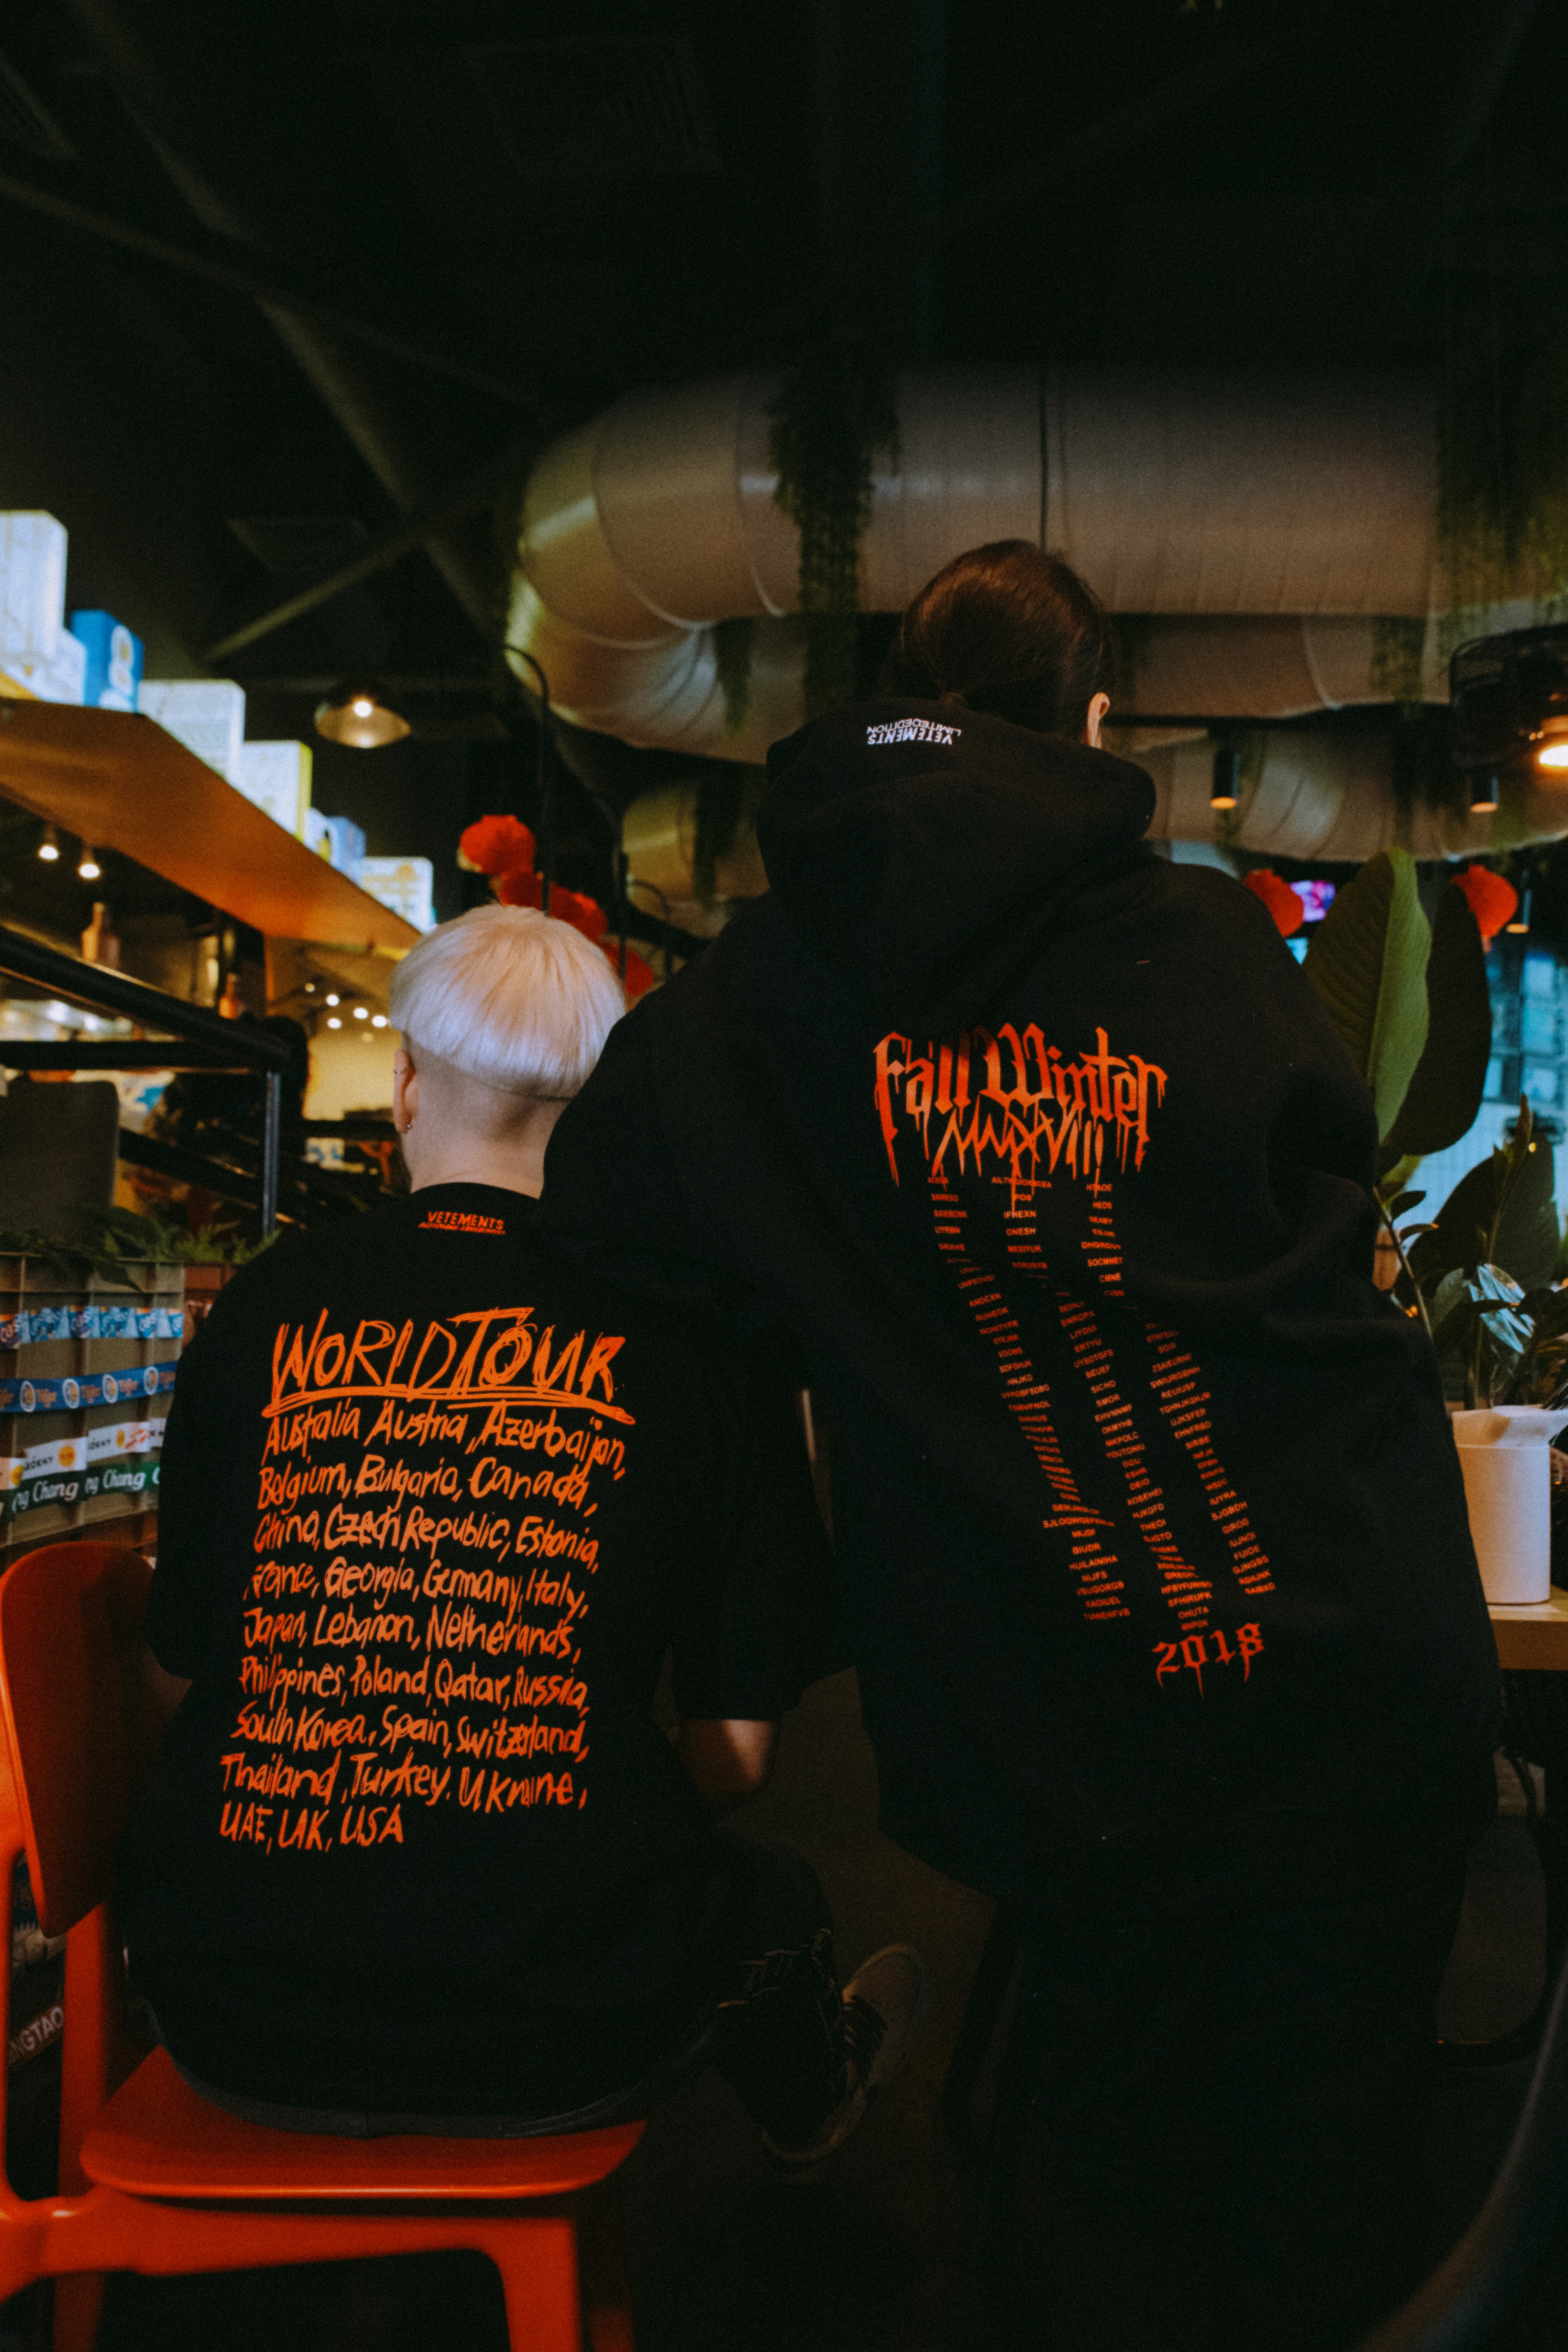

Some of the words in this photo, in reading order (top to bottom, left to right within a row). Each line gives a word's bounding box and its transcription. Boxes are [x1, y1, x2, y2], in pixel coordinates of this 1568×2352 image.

[867, 727, 952, 745] VETEMENTS
[873, 1030, 973, 1161] Fall
[973, 1022, 1168, 1158] Winter
[428, 1211, 504, 1230] VETEMENTS
[1152, 1623, 1265, 1686] 2018
[340, 1803, 404, 1847] USA
